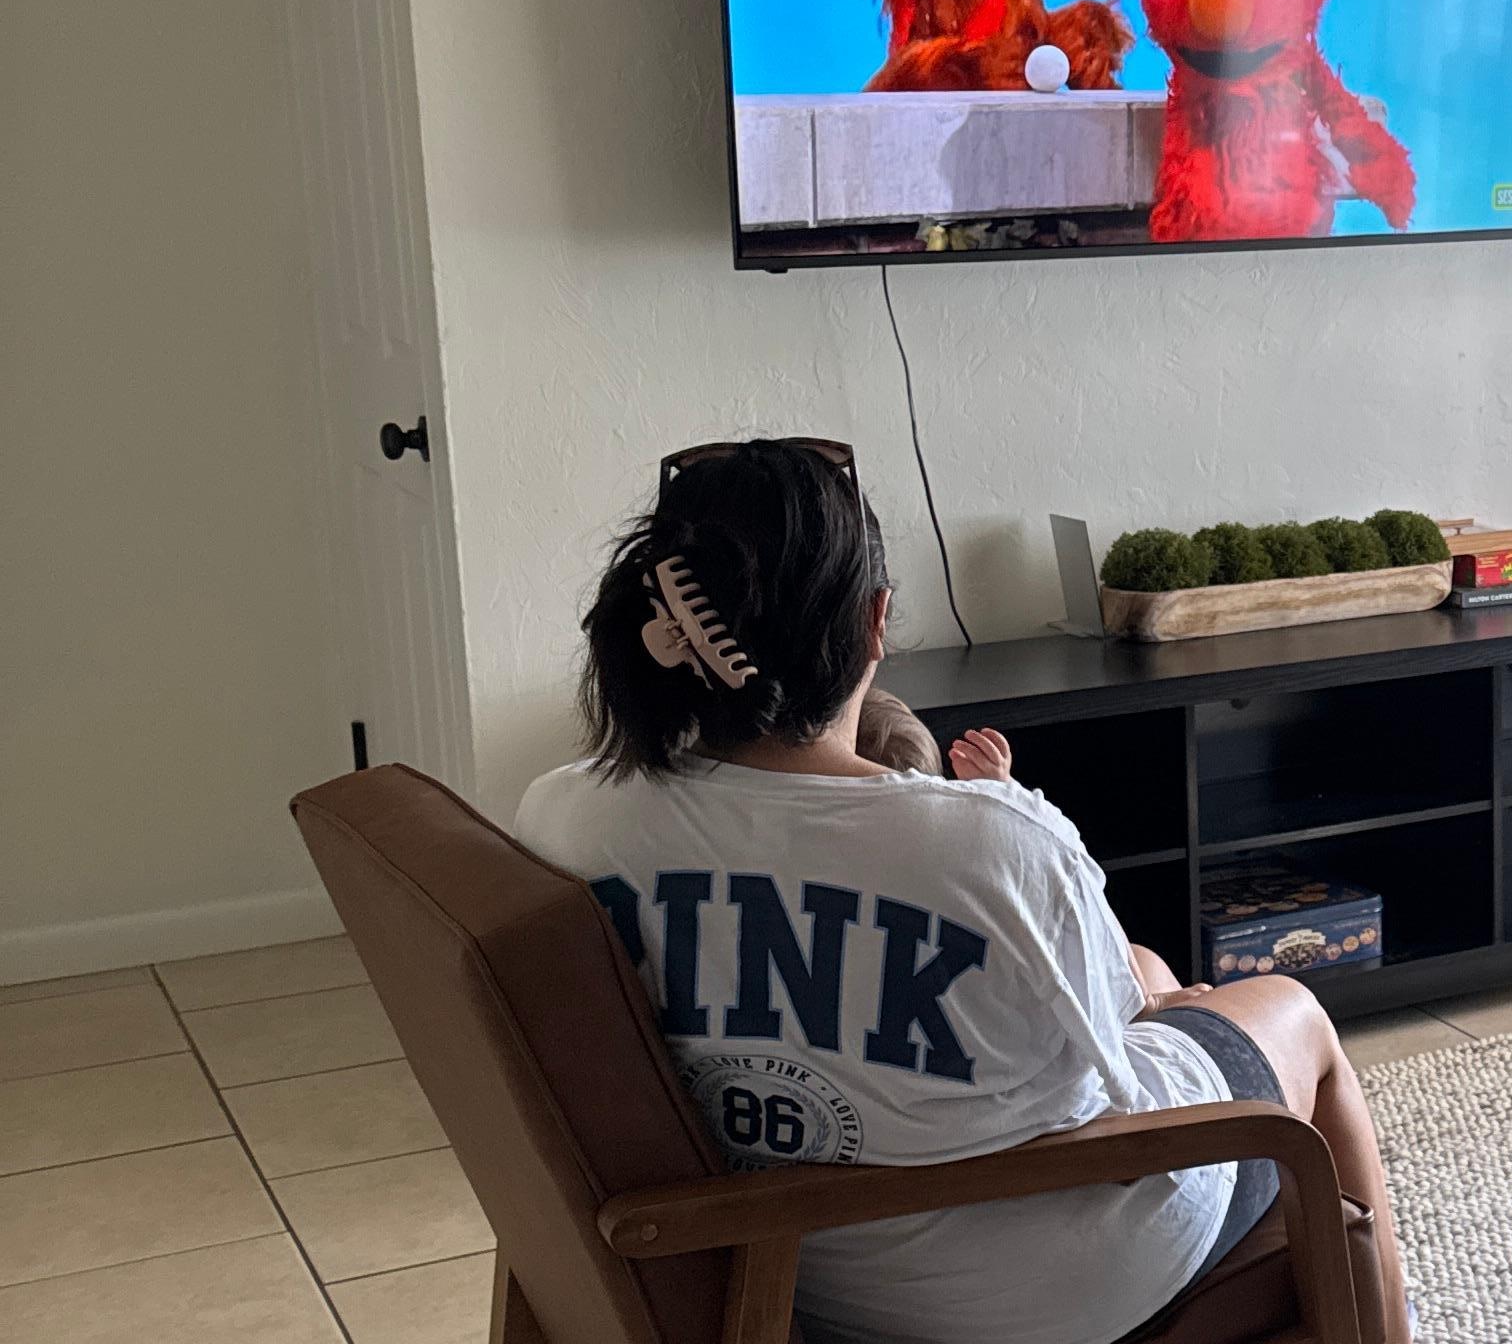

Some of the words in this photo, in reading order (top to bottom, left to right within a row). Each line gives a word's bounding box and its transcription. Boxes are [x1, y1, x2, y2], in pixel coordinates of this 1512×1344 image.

[711, 1056, 754, 1070] LOVE
[765, 1058, 812, 1083] PINK
[722, 1086, 805, 1155] 86
[829, 1097, 859, 1132] LOVE
[839, 1136, 859, 1164] PIN
